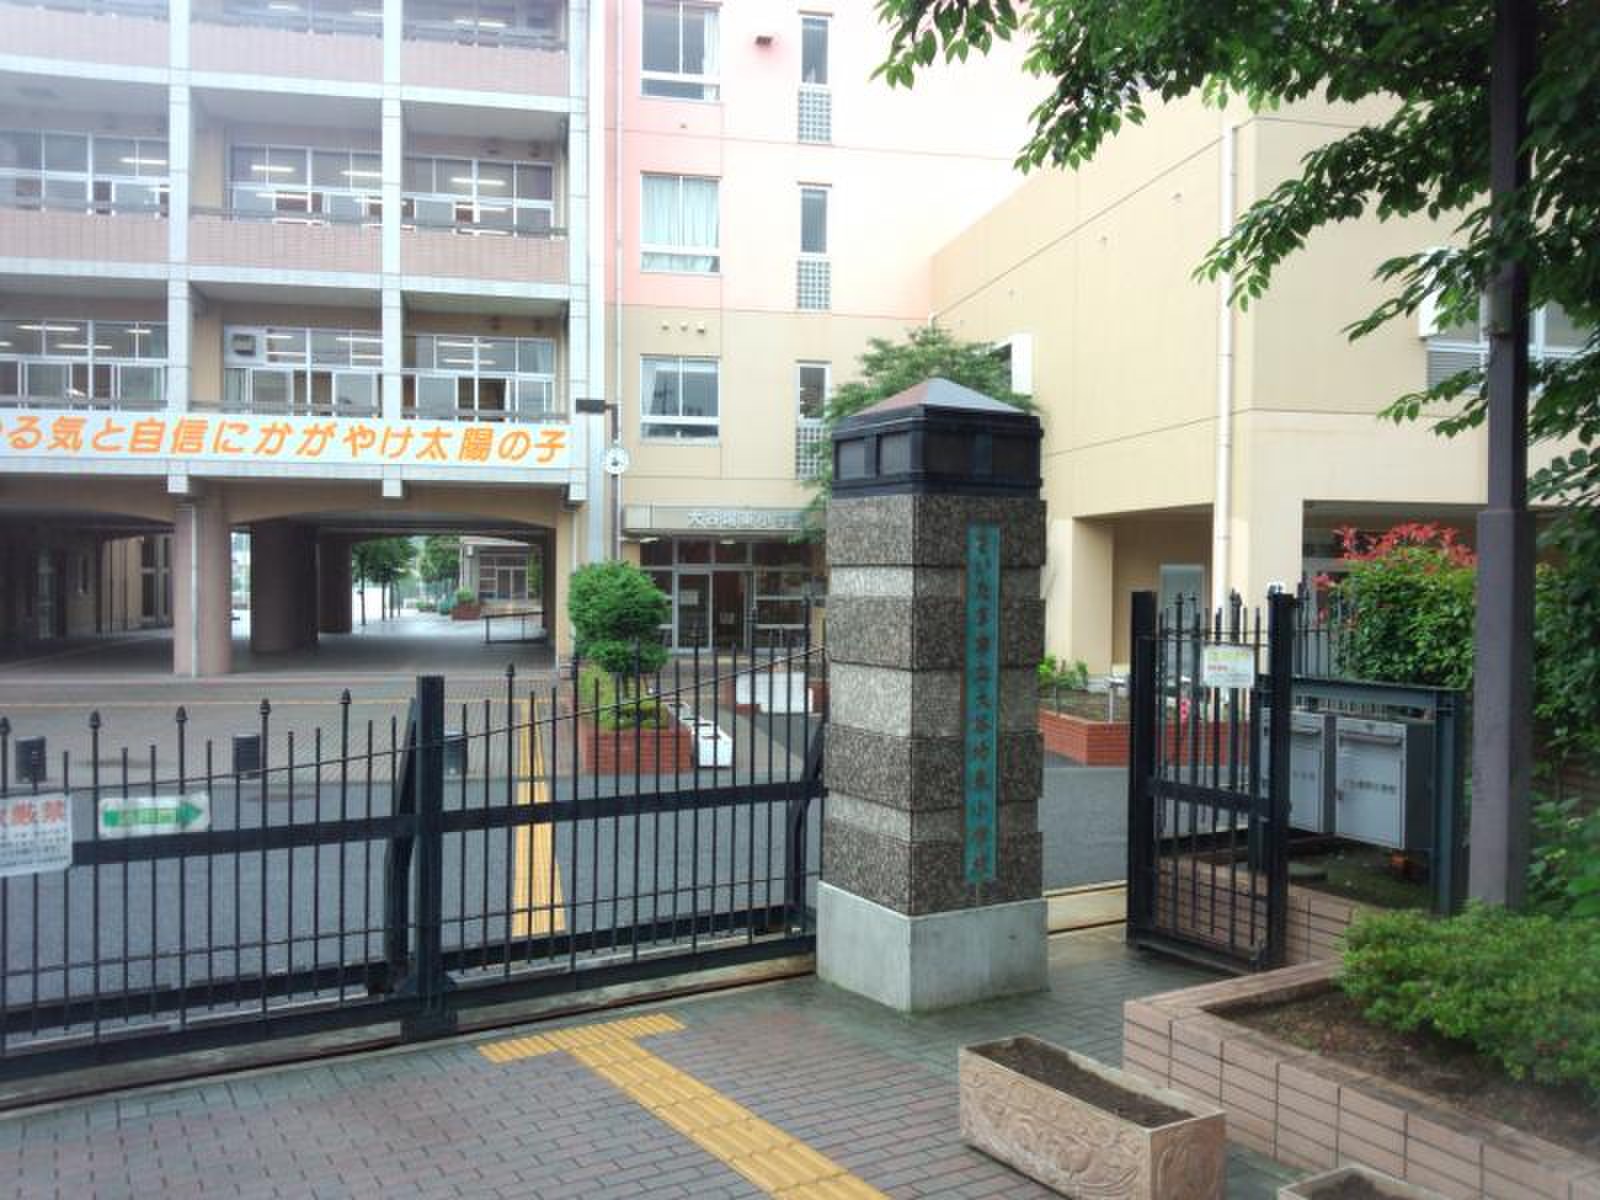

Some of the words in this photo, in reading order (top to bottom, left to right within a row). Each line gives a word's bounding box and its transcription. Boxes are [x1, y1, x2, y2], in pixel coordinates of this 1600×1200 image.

[0, 415, 567, 464] る気と自信にかがやけ太陽の子
